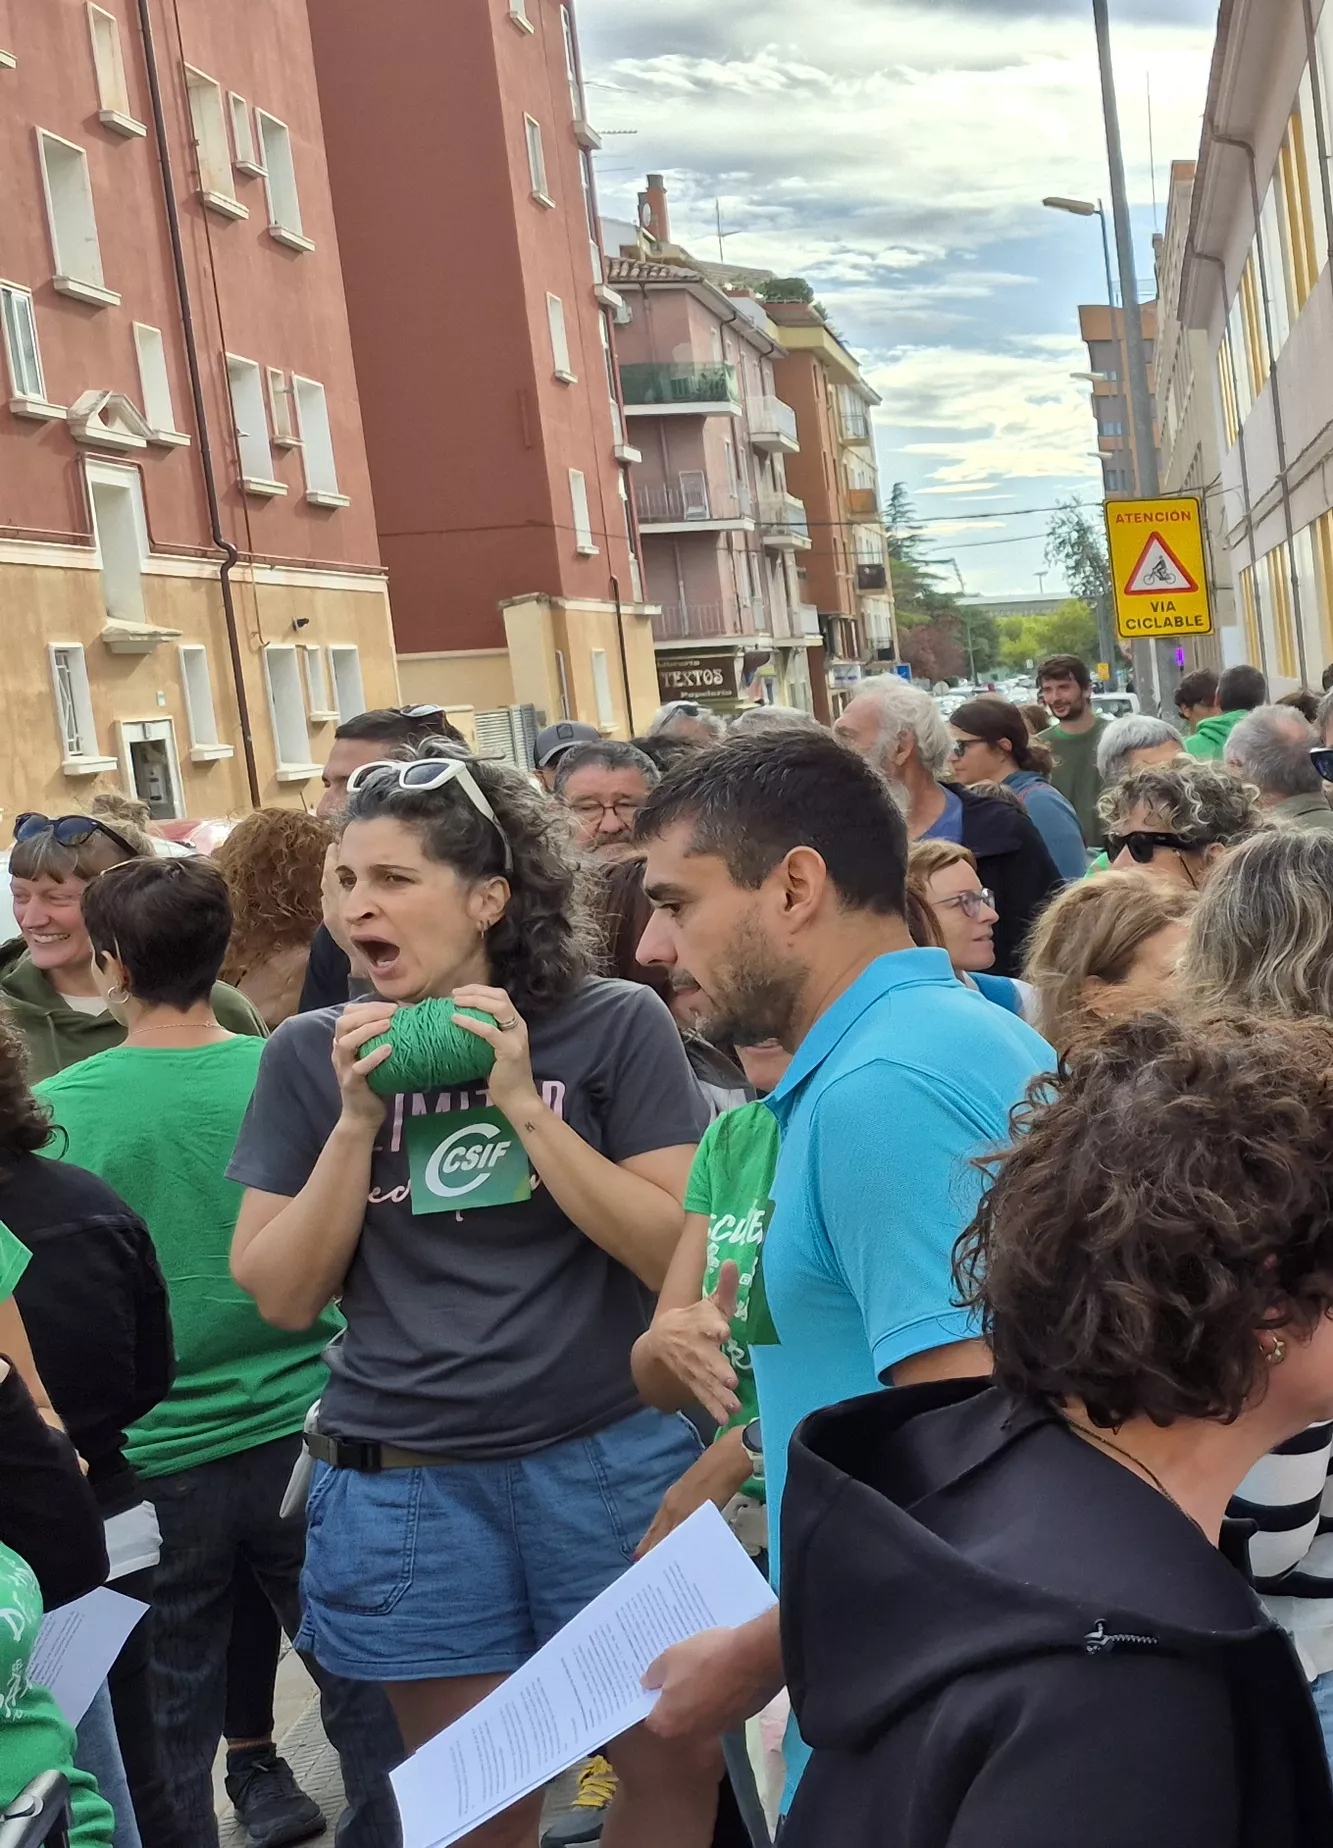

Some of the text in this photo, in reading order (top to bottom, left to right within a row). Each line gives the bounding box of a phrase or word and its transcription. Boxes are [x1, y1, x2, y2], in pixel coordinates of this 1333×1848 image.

[1116, 510, 1192, 524] ATENCIÓN
[1150, 601, 1176, 613] VIA
[1125, 615, 1204, 630] CICLABLE
[661, 669, 723, 687] TEXTOS
[442, 1141, 511, 1174] CSIF
